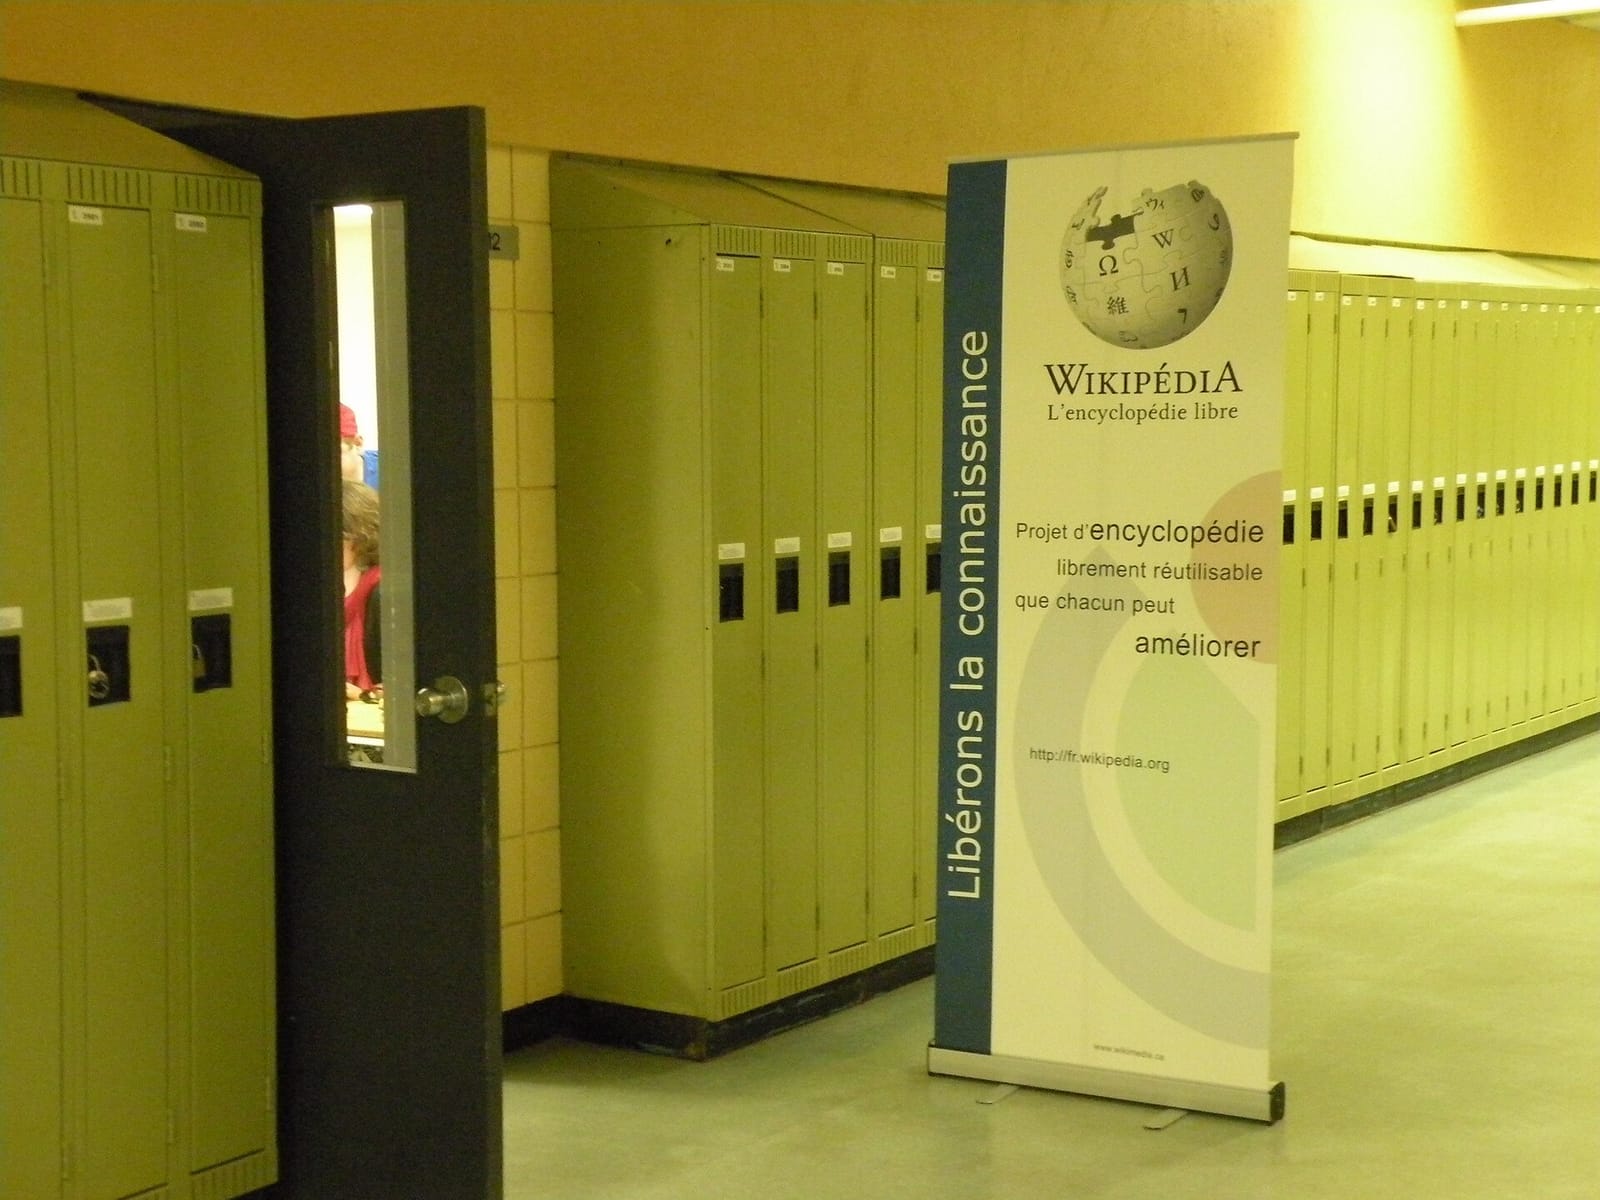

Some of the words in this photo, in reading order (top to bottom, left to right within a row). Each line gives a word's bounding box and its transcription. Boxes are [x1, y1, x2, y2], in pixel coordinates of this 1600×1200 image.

[1152, 228, 1174, 249] W
[1098, 254, 1119, 277] Ω
[1048, 403, 1187, 425] L'encyclopédie
[1195, 402, 1239, 420] libre
[952, 329, 989, 636] connaissance
[1016, 522, 1068, 543] Projet
[1073, 519, 1265, 549] d'encyclopédie
[1057, 559, 1147, 578] librement
[1153, 562, 1264, 581] réutilisable
[1015, 594, 1049, 611] que
[1056, 593, 1125, 611] chacun
[1132, 597, 1175, 616] peut
[1135, 633, 1262, 658] améliorer
[949, 656, 984, 691] la
[1029, 748, 1170, 773] http://fr.wikipedia.org
[945, 710, 983, 899] Libérons
